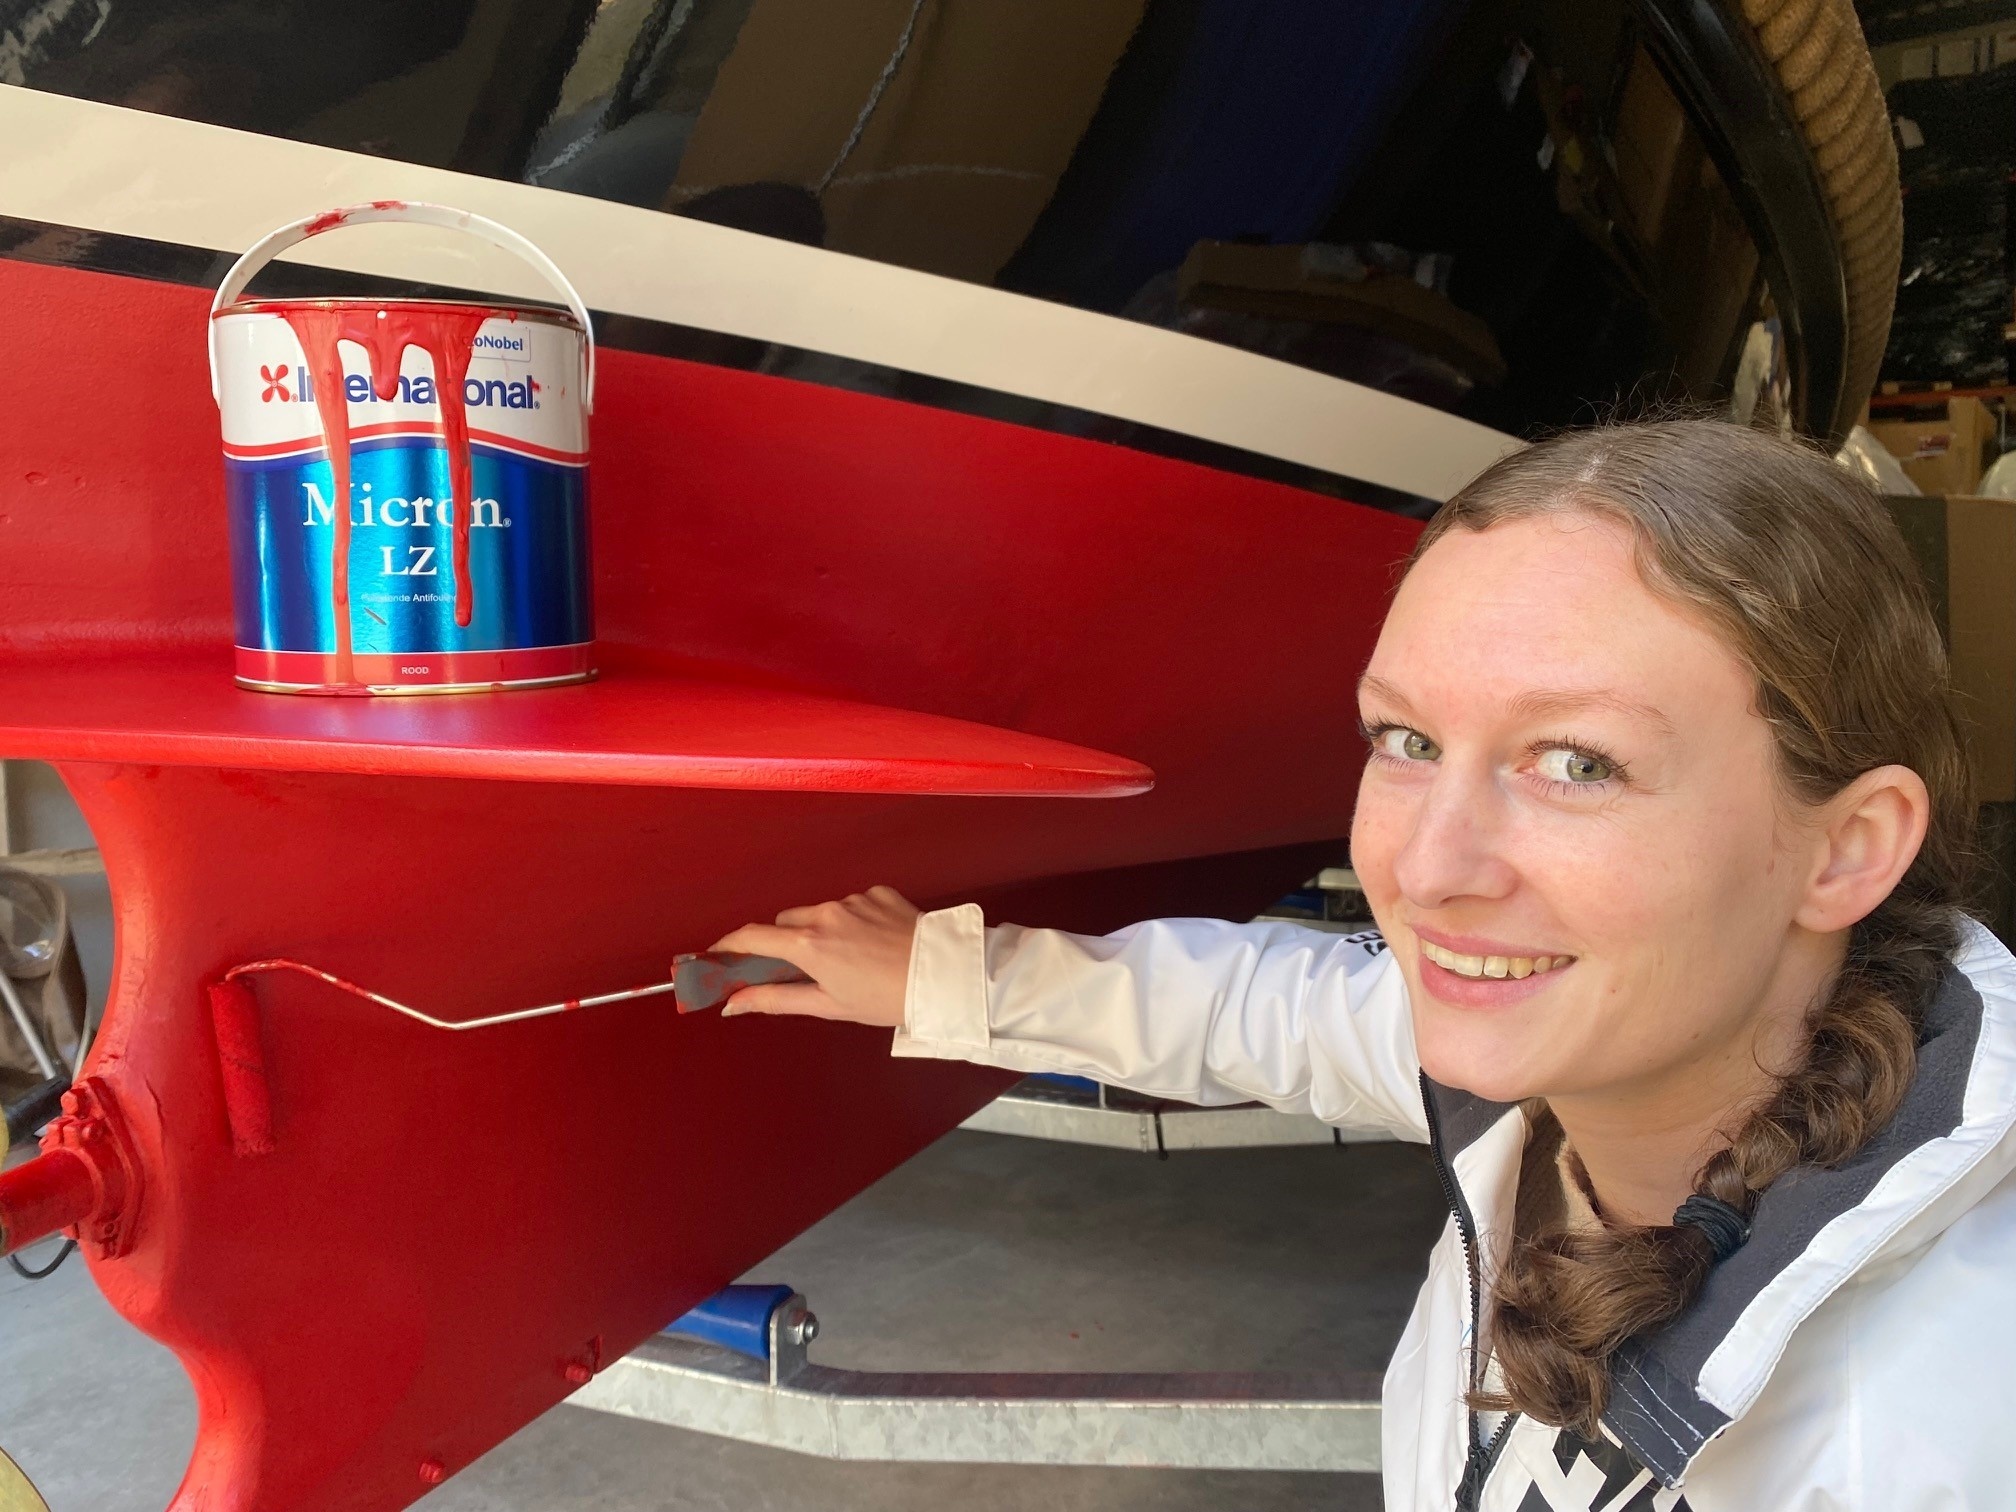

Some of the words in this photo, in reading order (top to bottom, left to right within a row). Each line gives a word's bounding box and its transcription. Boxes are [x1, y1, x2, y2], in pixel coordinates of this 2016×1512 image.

[471, 335, 524, 351] oNobel
[297, 366, 534, 409] Iernaonal
[379, 546, 438, 577] LZ
[401, 666, 429, 675] ROOD
